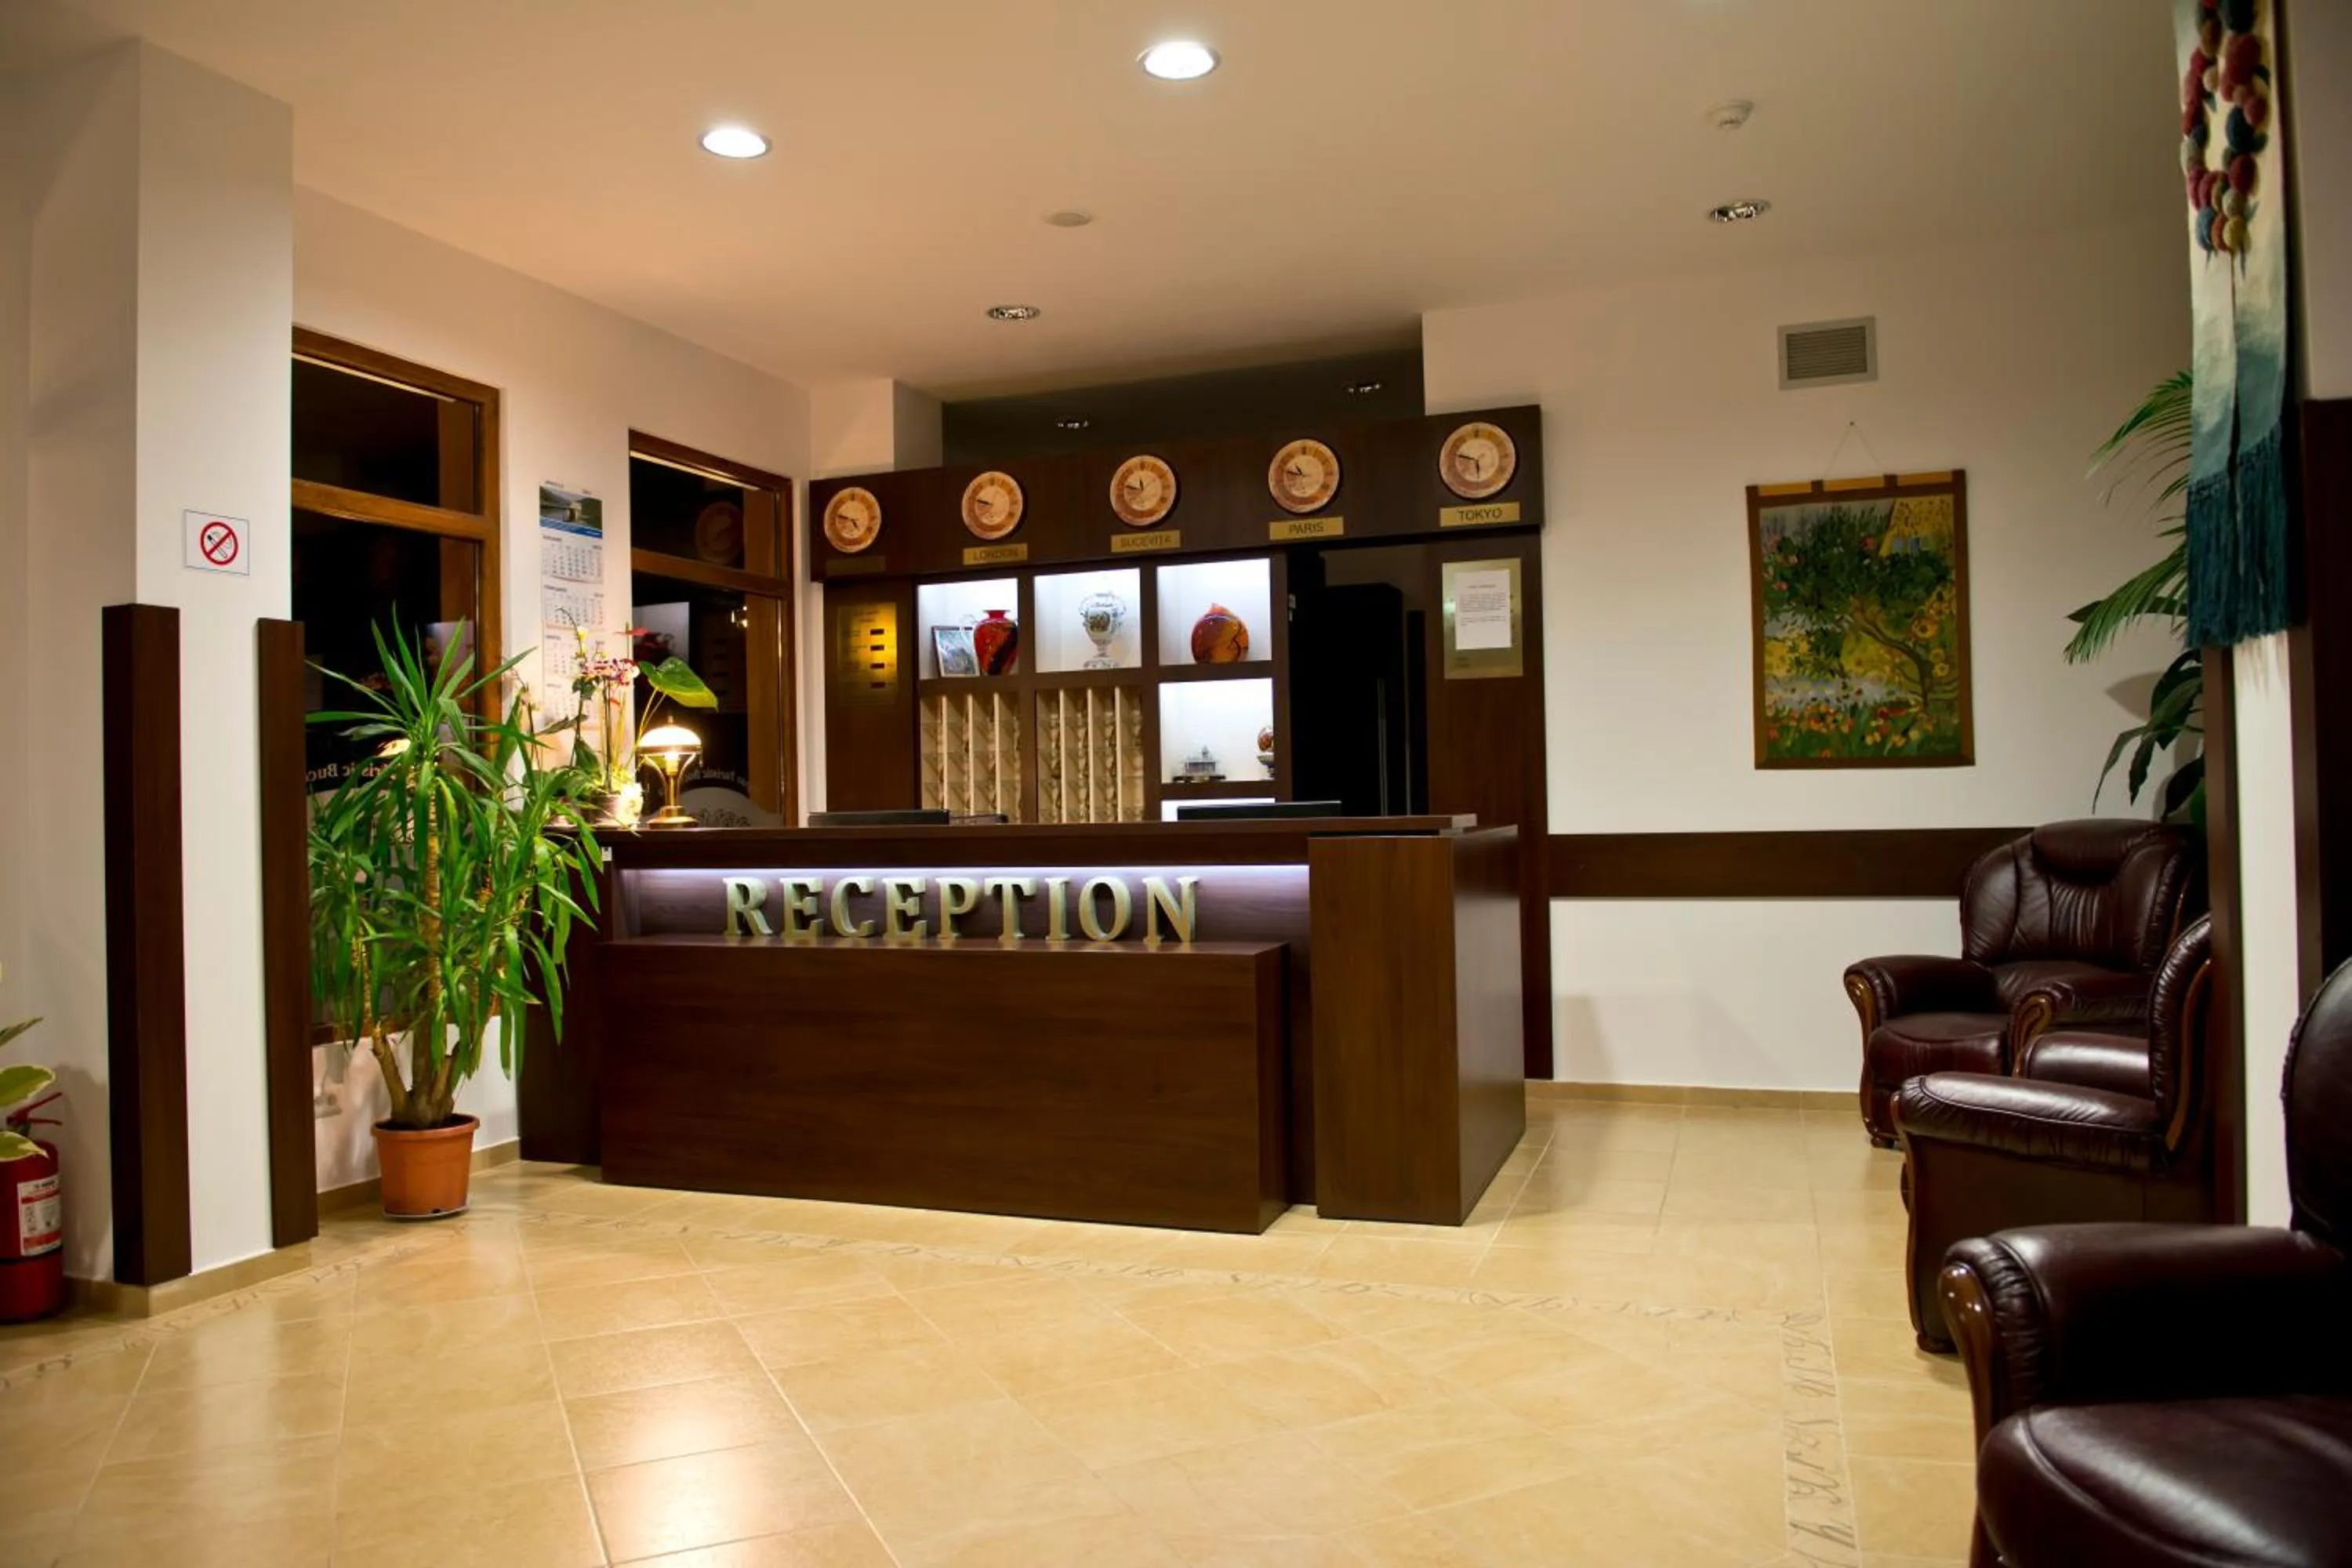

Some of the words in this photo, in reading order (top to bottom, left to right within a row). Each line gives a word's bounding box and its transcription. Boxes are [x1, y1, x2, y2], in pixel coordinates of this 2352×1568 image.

[1457, 508, 1501, 521] TOKYO
[1289, 522, 1324, 535] PARIS
[972, 547, 1018, 561] LONDON
[722, 877, 1200, 942] RECEPTION
